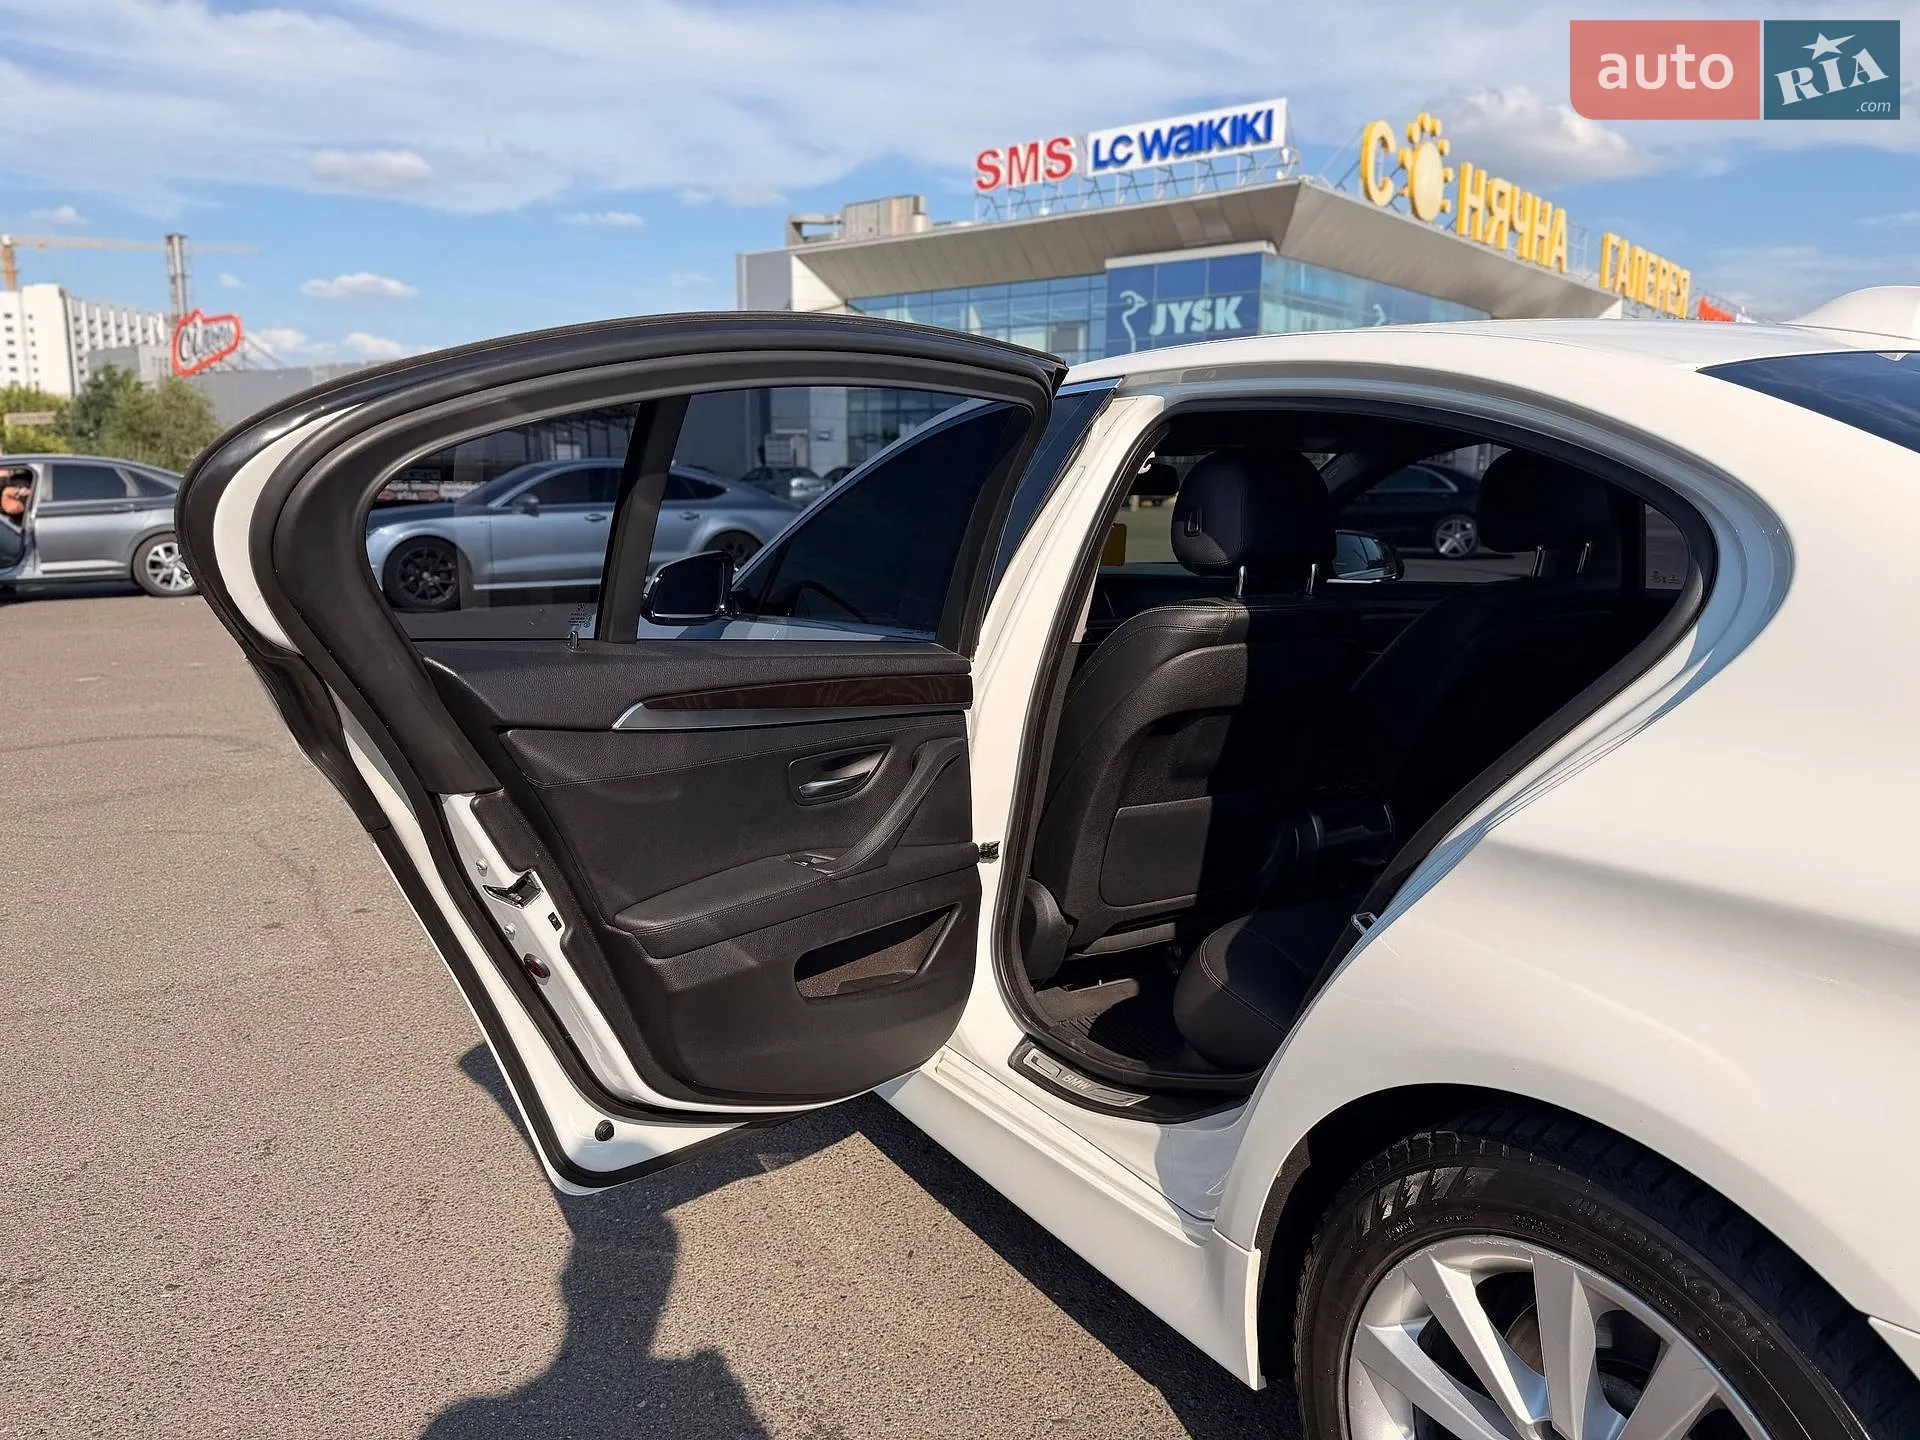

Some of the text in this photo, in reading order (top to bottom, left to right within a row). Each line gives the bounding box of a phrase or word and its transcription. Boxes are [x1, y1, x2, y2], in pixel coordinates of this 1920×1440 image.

[974, 136, 1076, 191] SMS
[1092, 134, 1134, 170] LC
[1600, 231, 1690, 320] ГАЛЕРЕЯ
[1149, 296, 1243, 336] JYSK
[1061, 1073, 1094, 1090] BMW
